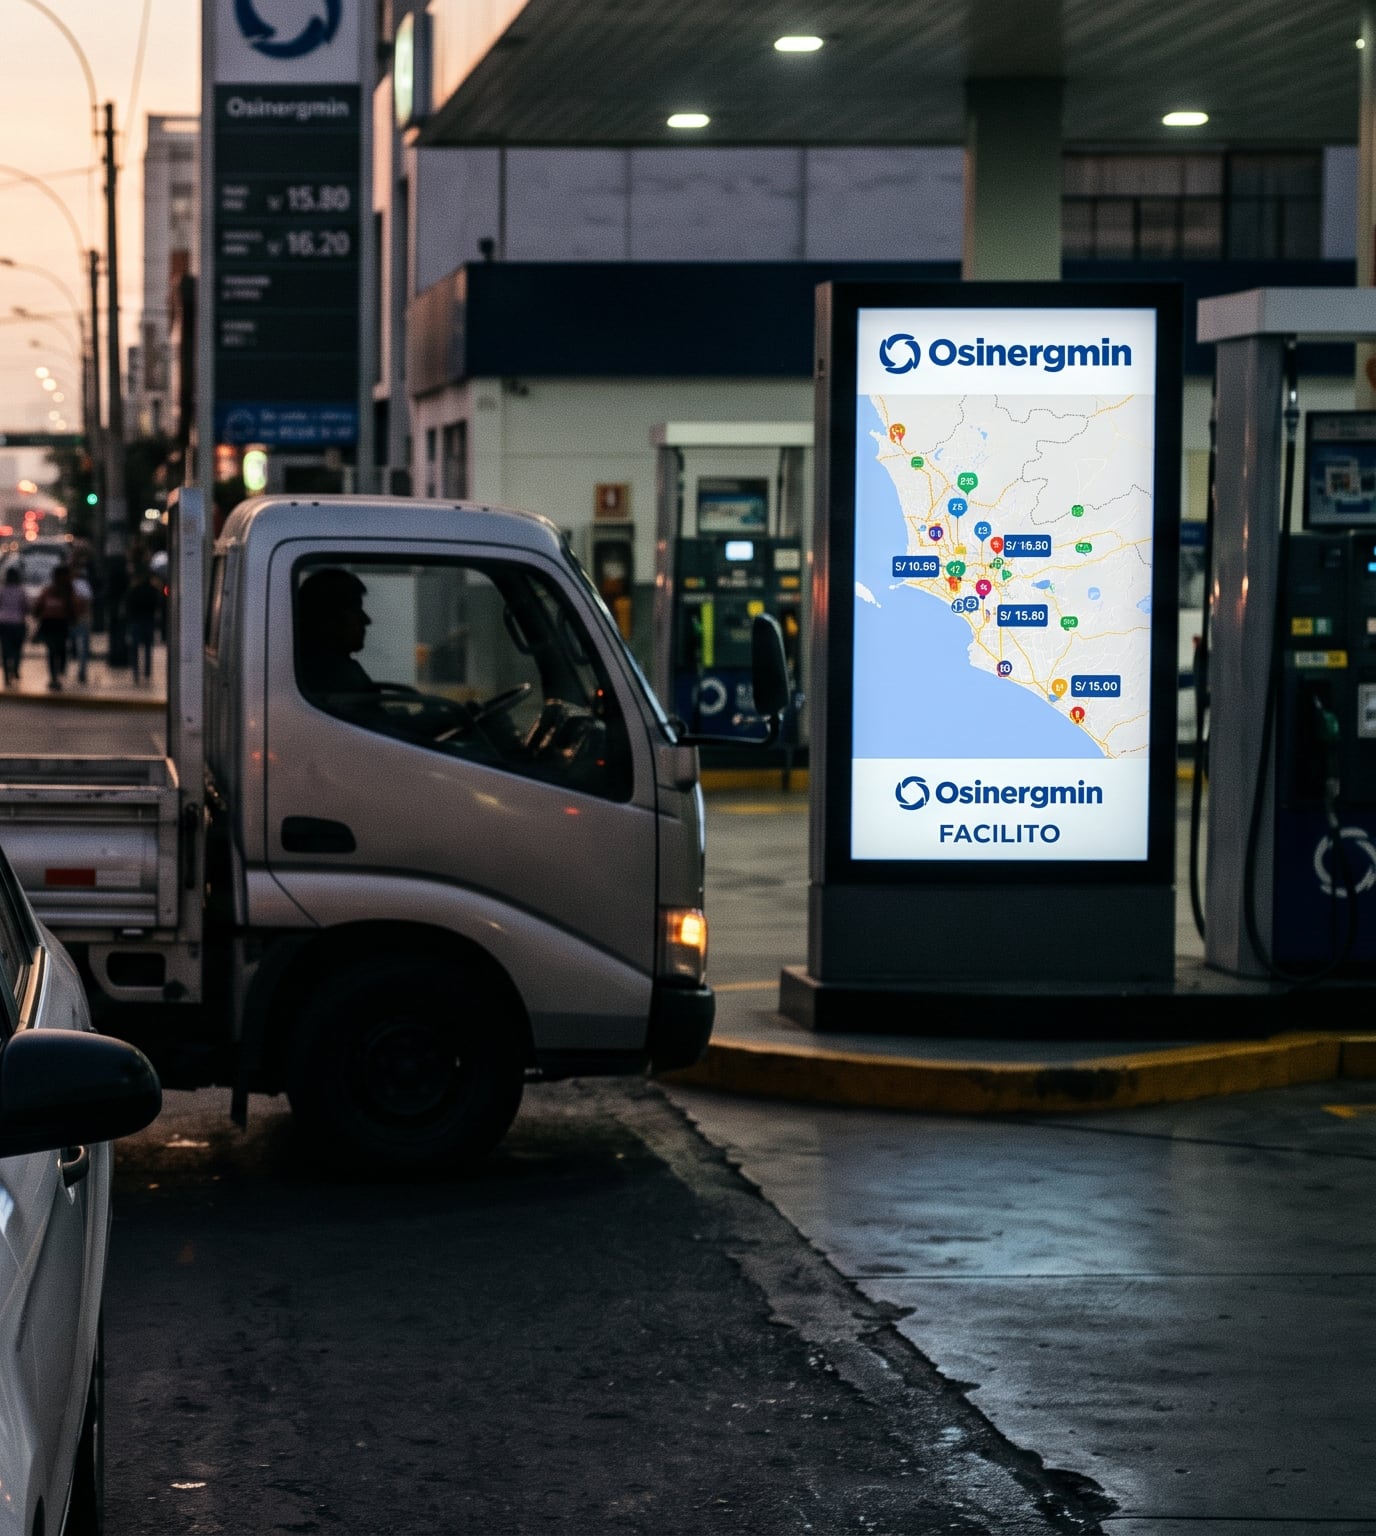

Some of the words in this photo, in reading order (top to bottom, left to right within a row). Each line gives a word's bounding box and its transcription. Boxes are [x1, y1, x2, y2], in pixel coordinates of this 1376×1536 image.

[226, 96, 350, 121] Osinergmin
[287, 231, 350, 257] 16.20
[928, 337, 1132, 373] Osinergmin
[1006, 540, 1017, 551] S/
[895, 561, 906, 572] S/
[1000, 610, 1012, 621] S/
[1075, 681, 1087, 692] S/
[1088, 681, 1118, 691] 15.00
[935, 779, 1103, 809] Osinergmin
[939, 824, 1060, 844] FACILITO
